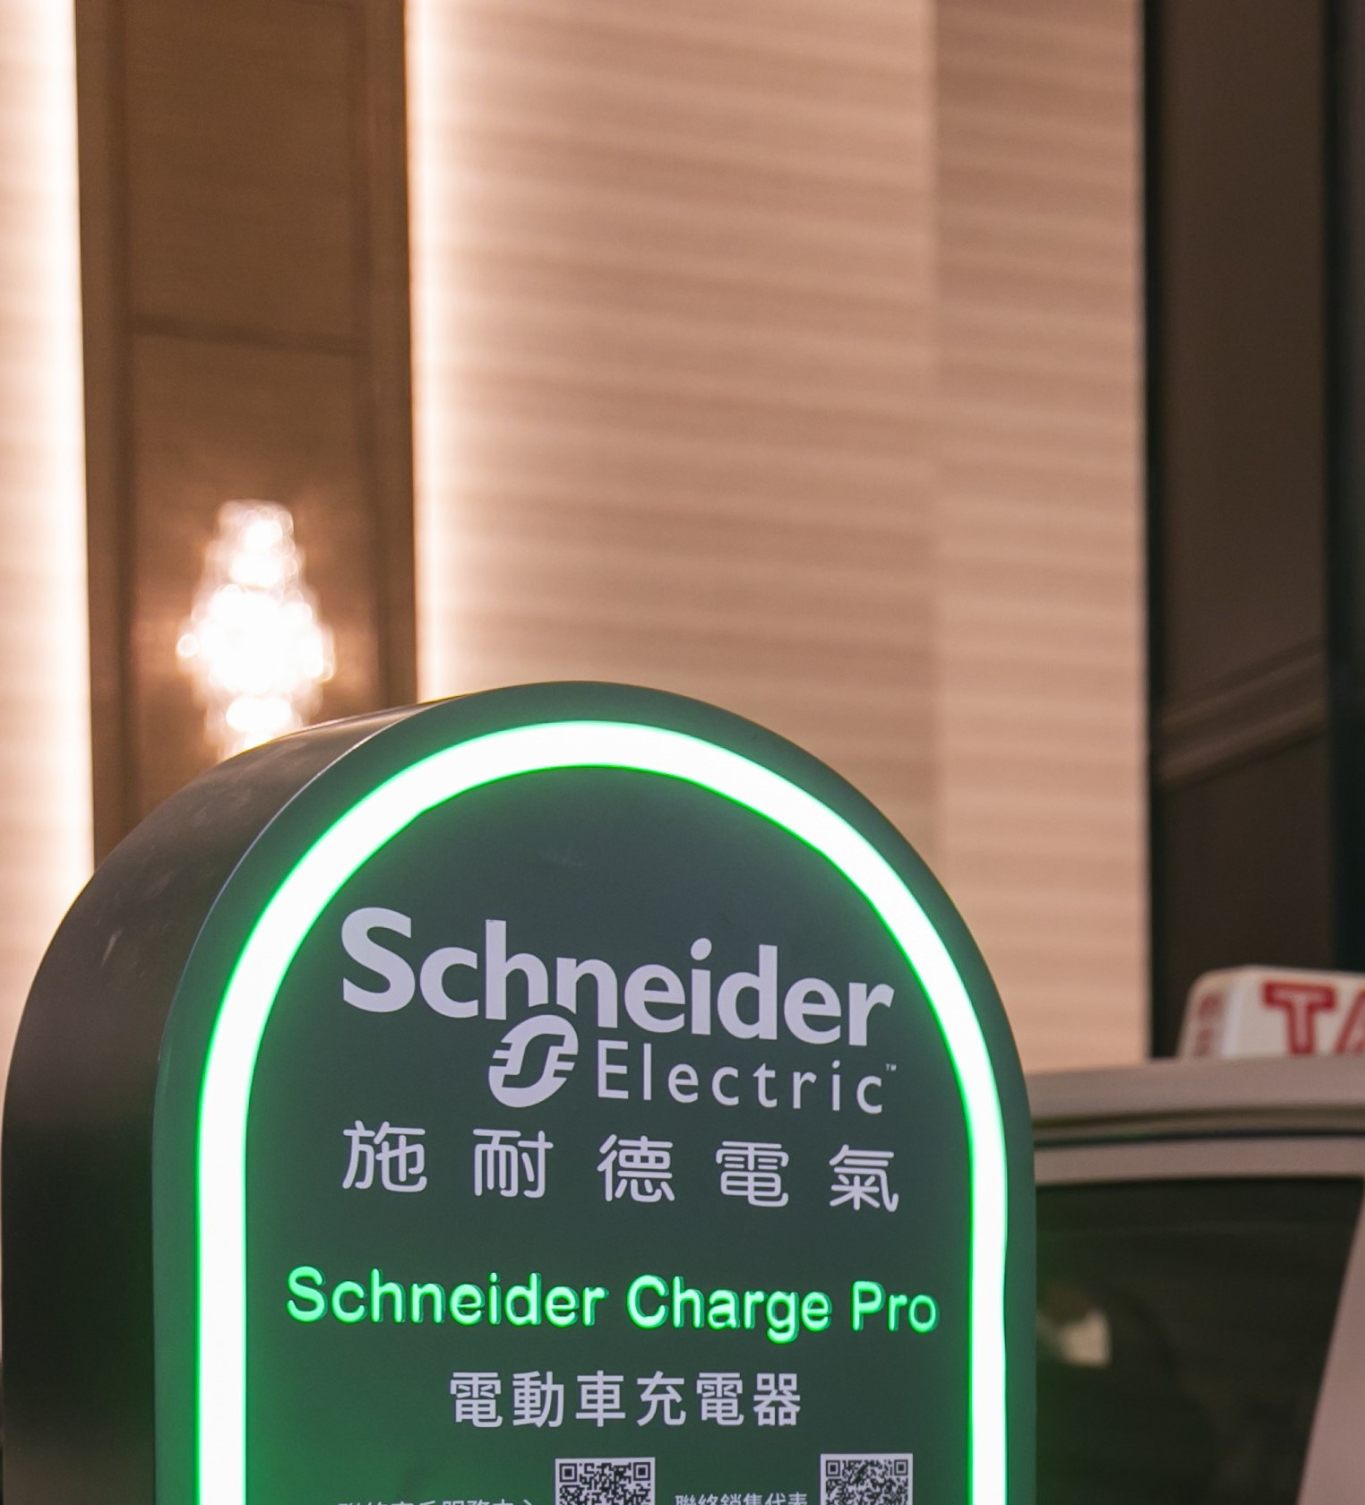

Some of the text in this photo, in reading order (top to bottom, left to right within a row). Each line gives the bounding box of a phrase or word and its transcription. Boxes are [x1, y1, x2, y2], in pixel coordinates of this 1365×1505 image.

[341, 907, 895, 1046] Schneider
[596, 1039, 884, 1114] Electric
[342, 1120, 899, 1212] 施耐德電氣
[286, 1266, 938, 1343] Schneider Charge Pro
[449, 1370, 801, 1427] 電動車充電器
